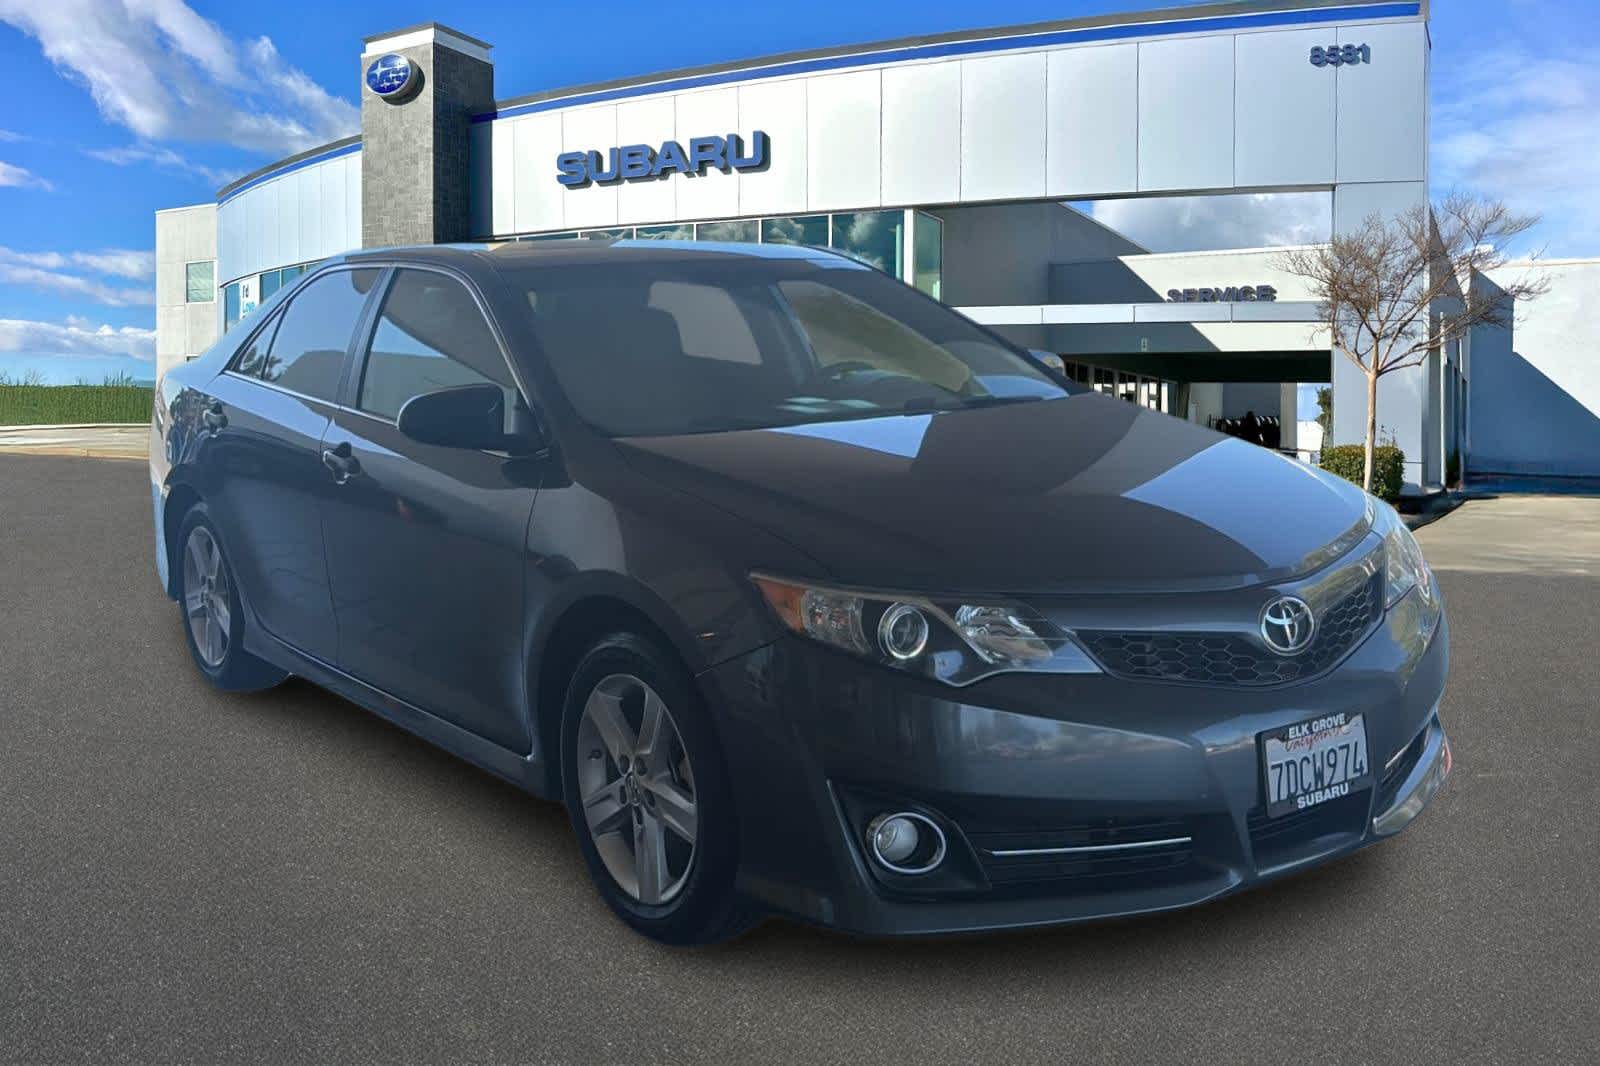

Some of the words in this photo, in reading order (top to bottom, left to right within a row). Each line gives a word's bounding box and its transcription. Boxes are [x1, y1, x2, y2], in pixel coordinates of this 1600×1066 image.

[556, 130, 771, 190] SUBARU
[1166, 284, 1278, 303] SERVICE
[1288, 724, 1310, 739] ELK
[1312, 713, 1346, 732] GROVE
[1271, 741, 1365, 801] 7DCW974
[1297, 782, 1349, 809] SUBARU
